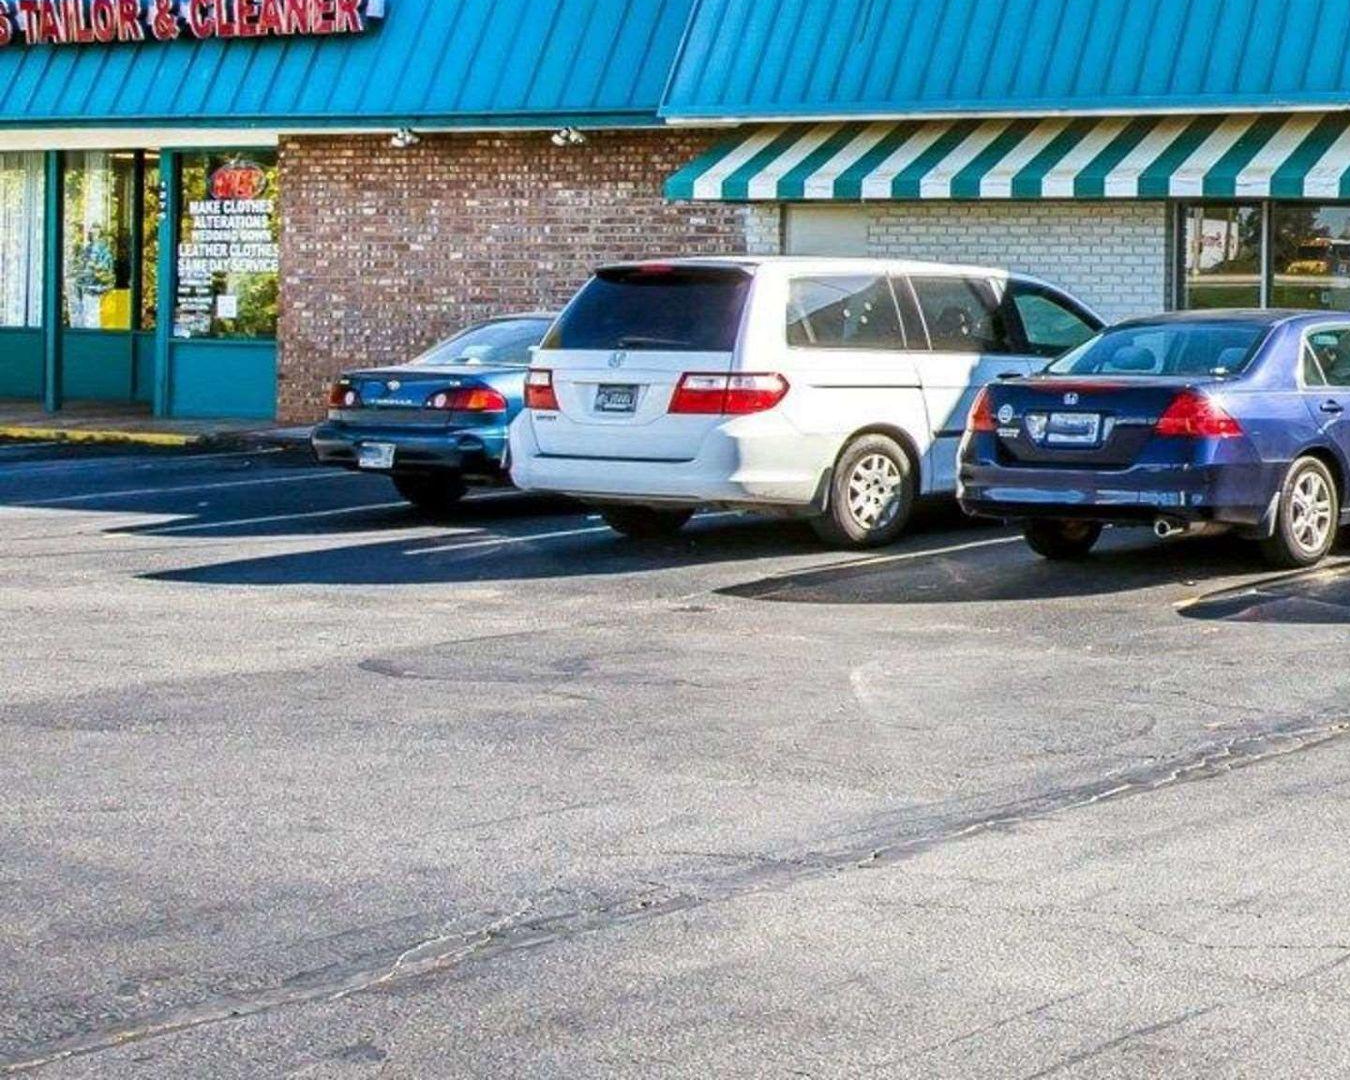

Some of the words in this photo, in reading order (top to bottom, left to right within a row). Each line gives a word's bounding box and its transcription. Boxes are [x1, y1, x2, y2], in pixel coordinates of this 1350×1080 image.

[189, 201, 221, 214] MAKE
[223, 199, 274, 214] CLOTHES
[193, 215, 269, 229] ALTERATIONS
[178, 243, 228, 257] LEATHER
[230, 243, 279, 257] CLOTHES
